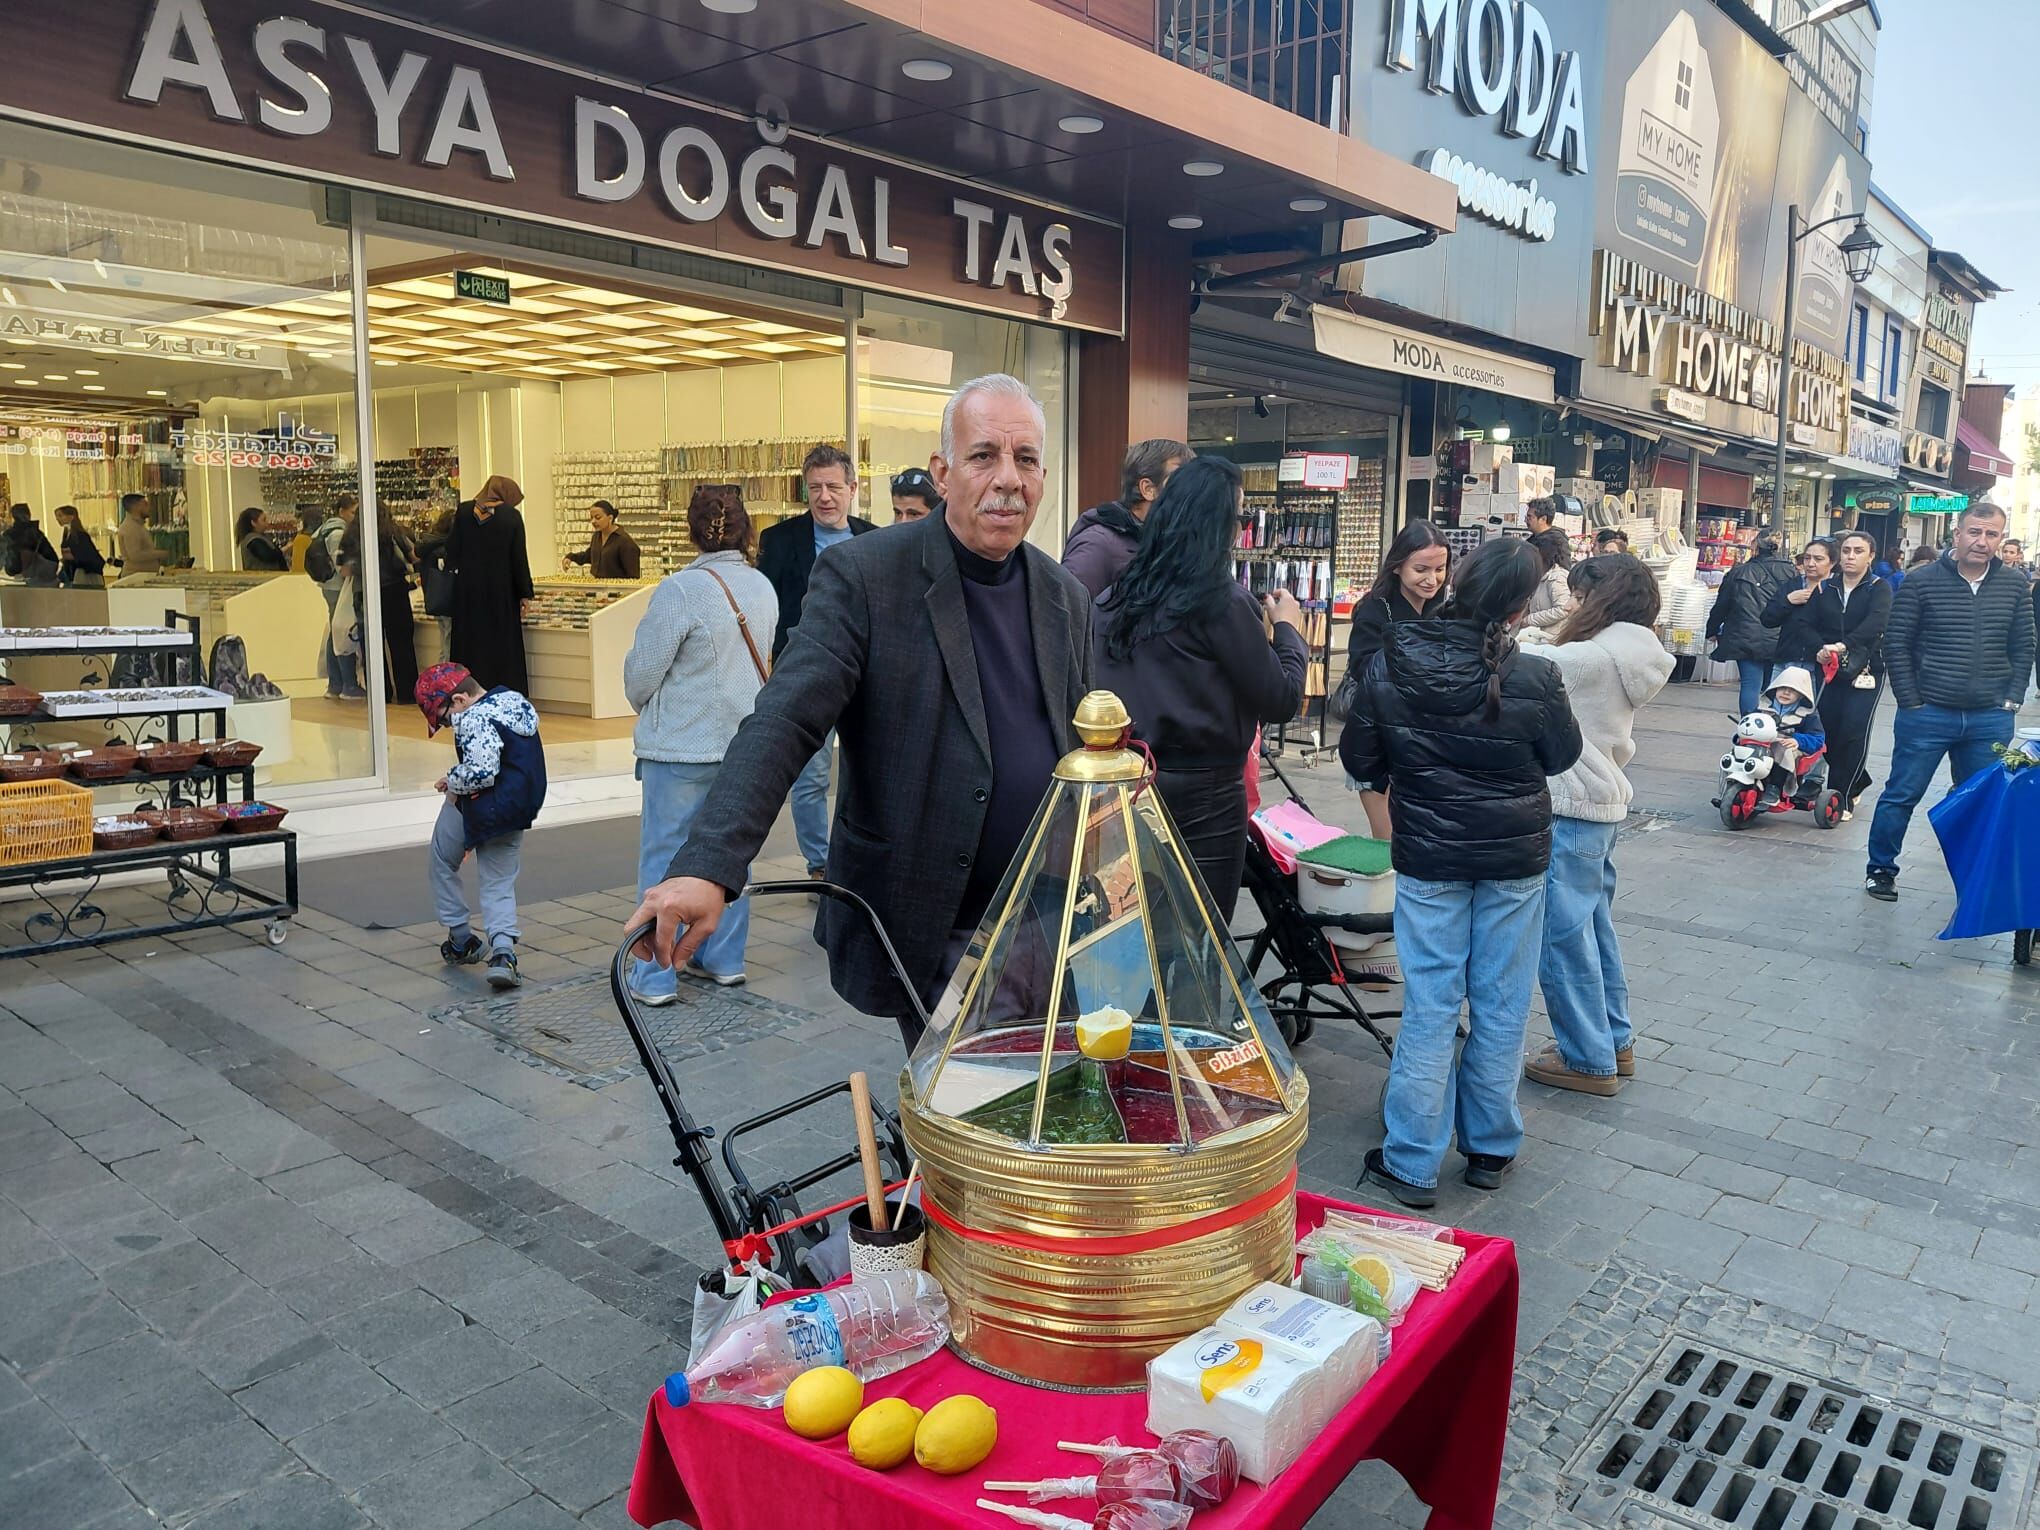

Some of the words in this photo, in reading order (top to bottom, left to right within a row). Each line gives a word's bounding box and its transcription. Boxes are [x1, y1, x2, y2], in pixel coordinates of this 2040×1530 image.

[1388, 0, 1588, 174] MODA
[124, 0, 515, 182] ASYA
[574, 96, 909, 269] DOĞAL
[953, 198, 1074, 320] TAŞ
[1642, 122, 1663, 156] MY
[1666, 136, 1702, 178] HOME
[485, 279, 506, 292] EXIT
[1393, 338, 1446, 374] MODA
[1452, 363, 1505, 388] accessories
[1613, 299, 1665, 377] MY
[1675, 321, 1752, 404] HOME
[1797, 370, 1843, 432] HOME
[1248, 1297, 1272, 1313] Sens
[1200, 1342, 1236, 1365] Sens
